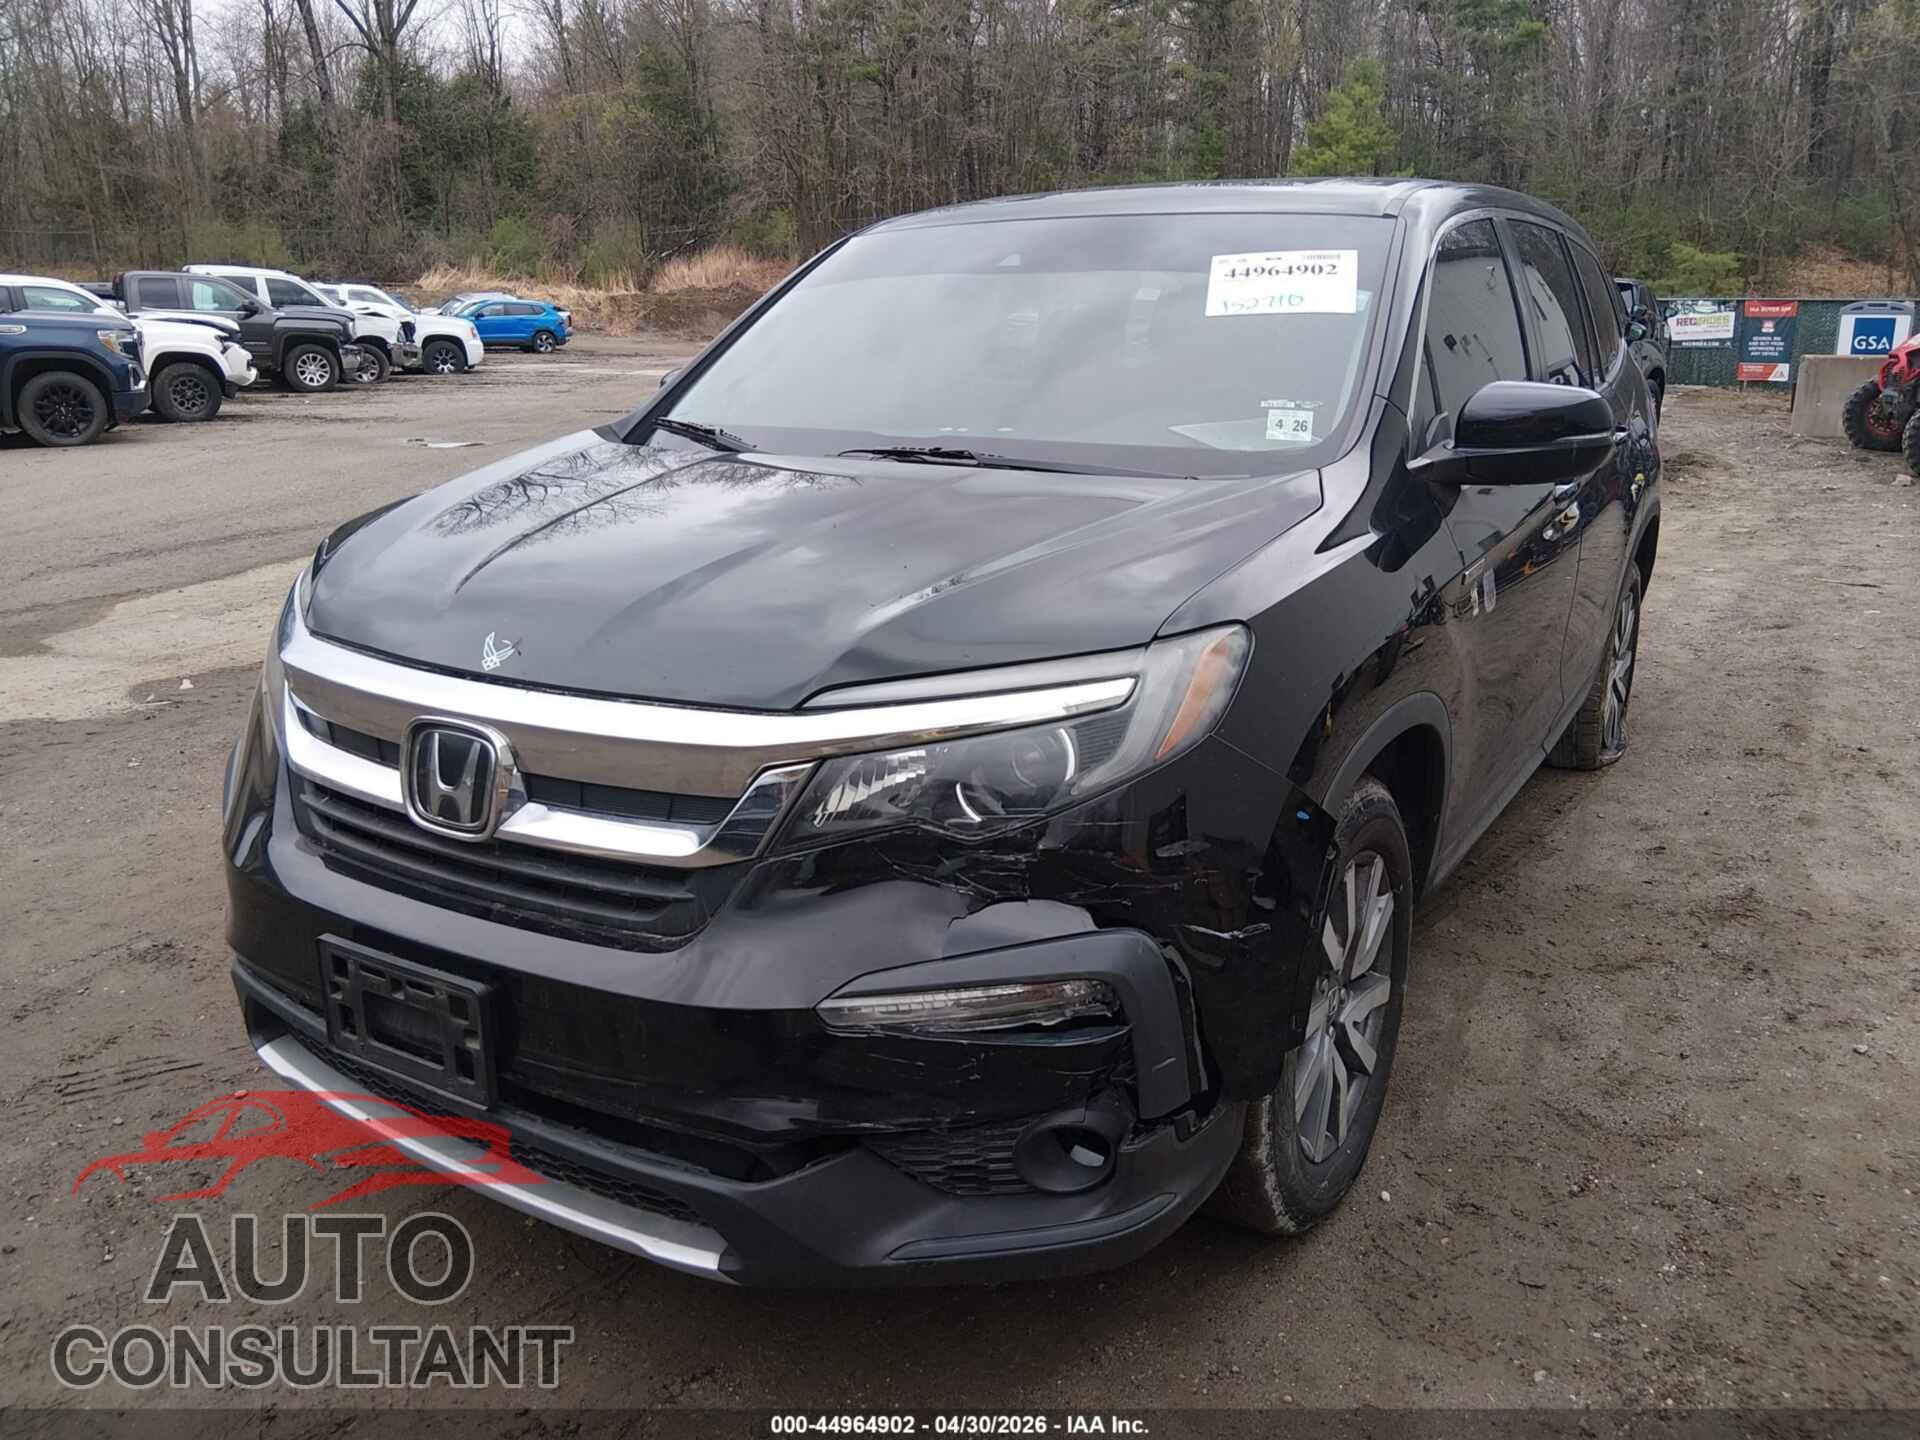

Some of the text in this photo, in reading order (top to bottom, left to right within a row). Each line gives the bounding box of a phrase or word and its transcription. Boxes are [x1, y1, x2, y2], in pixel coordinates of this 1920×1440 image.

[1223, 263, 1338, 279] 44964902
[1854, 335, 1890, 350] GSA
[1275, 419, 1308, 432] 4 26
